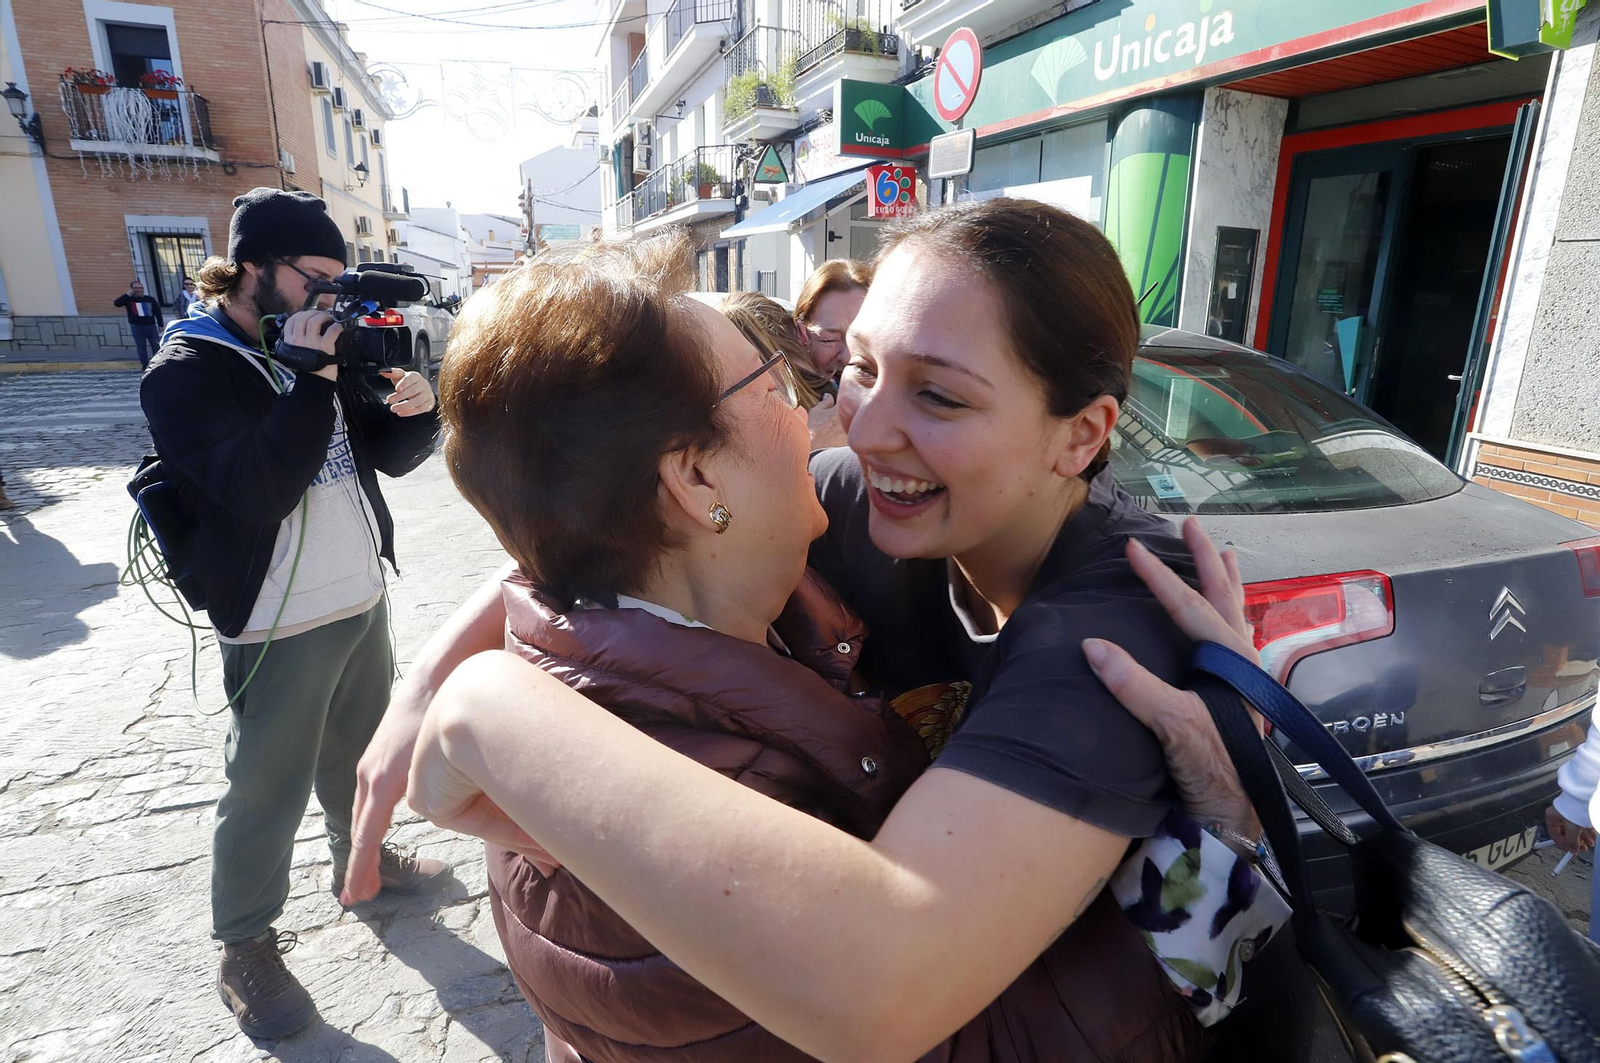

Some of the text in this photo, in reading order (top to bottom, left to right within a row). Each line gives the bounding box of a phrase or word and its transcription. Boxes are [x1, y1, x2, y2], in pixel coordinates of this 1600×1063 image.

[1094, 0, 1235, 81] Unicaja
[855, 132, 890, 146] Unicaja
[875, 206, 894, 214] EURO
